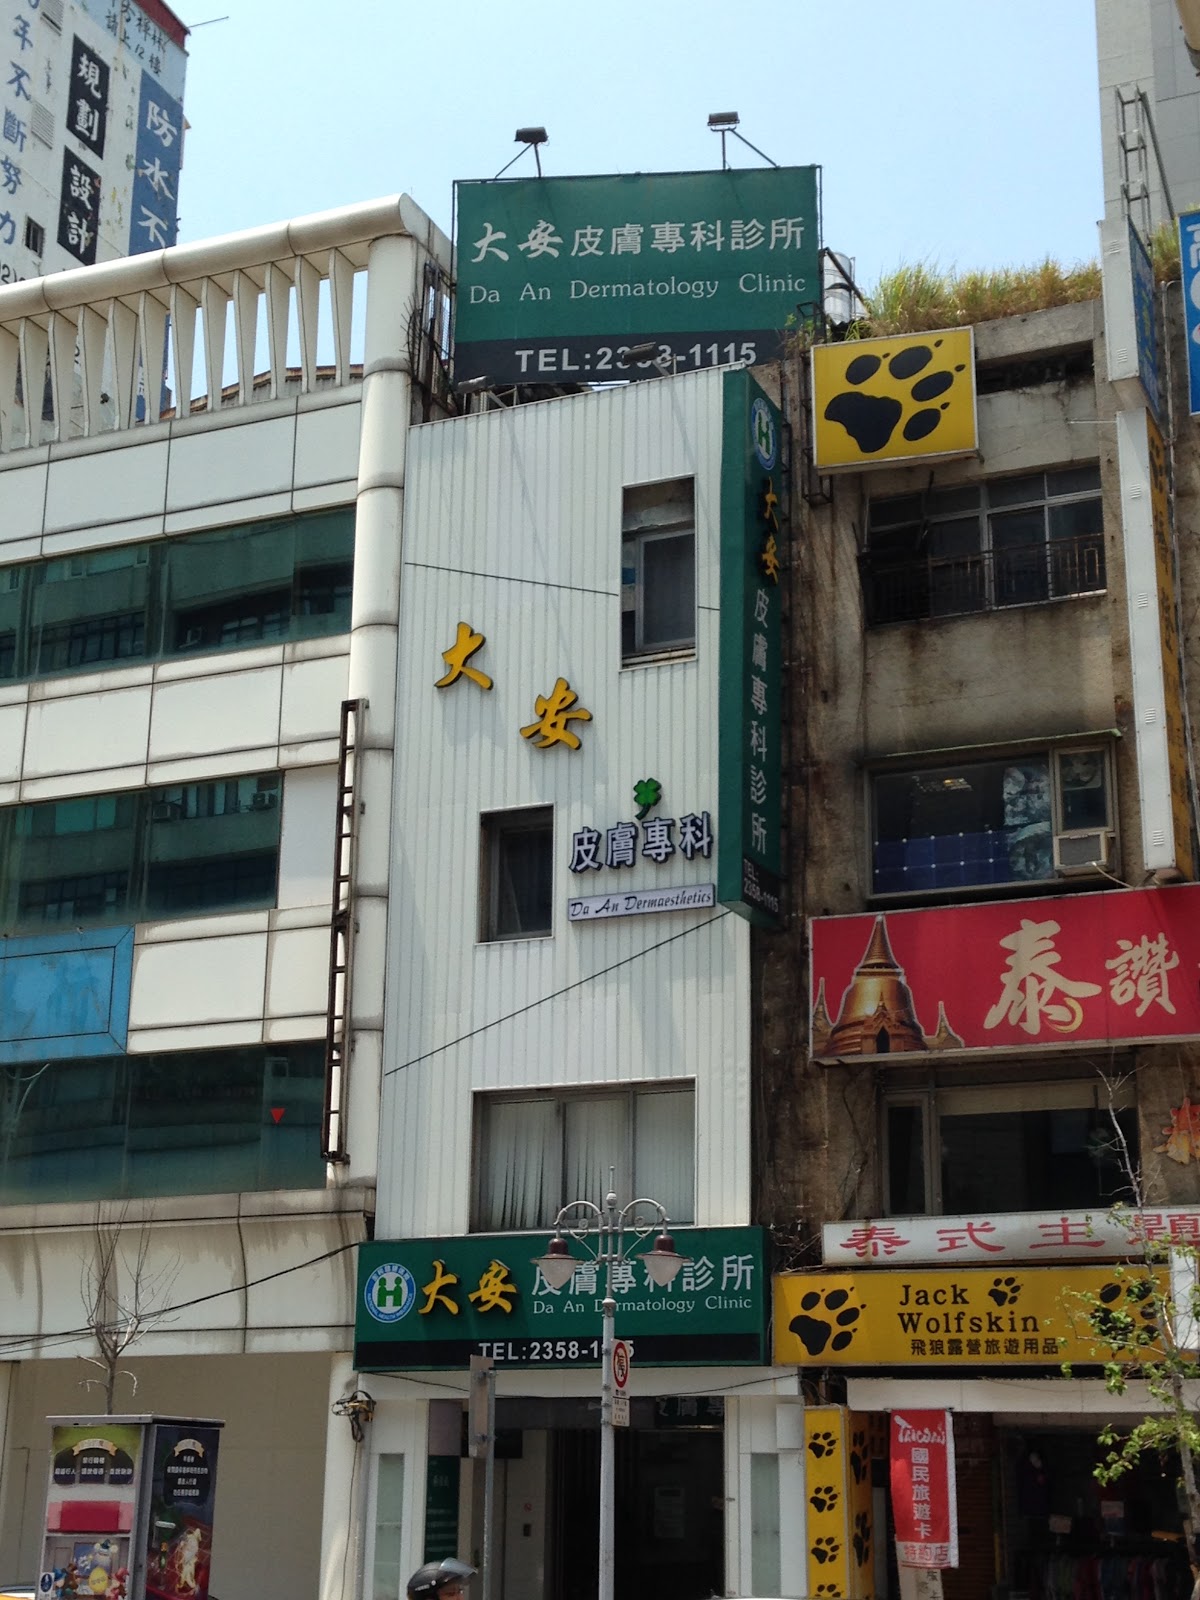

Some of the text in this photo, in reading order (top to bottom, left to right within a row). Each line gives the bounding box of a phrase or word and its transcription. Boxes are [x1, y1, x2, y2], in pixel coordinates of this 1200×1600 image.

[471, 217, 804, 263] 大安皮膚專科診所
[469, 273, 806, 304] Da An Dermatology Clinic
[515, 342, 757, 373] TEL:238-1115
[569, 811, 714, 873] 皮膚專科
[571, 902, 590, 917] Da
[595, 898, 620, 914] An
[418, 1260, 518, 1315] 大安
[899, 1284, 969, 1306] Jack
[533, 1295, 752, 1314] Da An Drmatology Clinic
[897, 1311, 1040, 1334] Wolfskin
[478, 1340, 635, 1361] TEL:2358-15
[911, 1338, 1059, 1356] 飛狼露營旅遊用品
[911, 1447, 932, 1539] 國民旅遊卡
